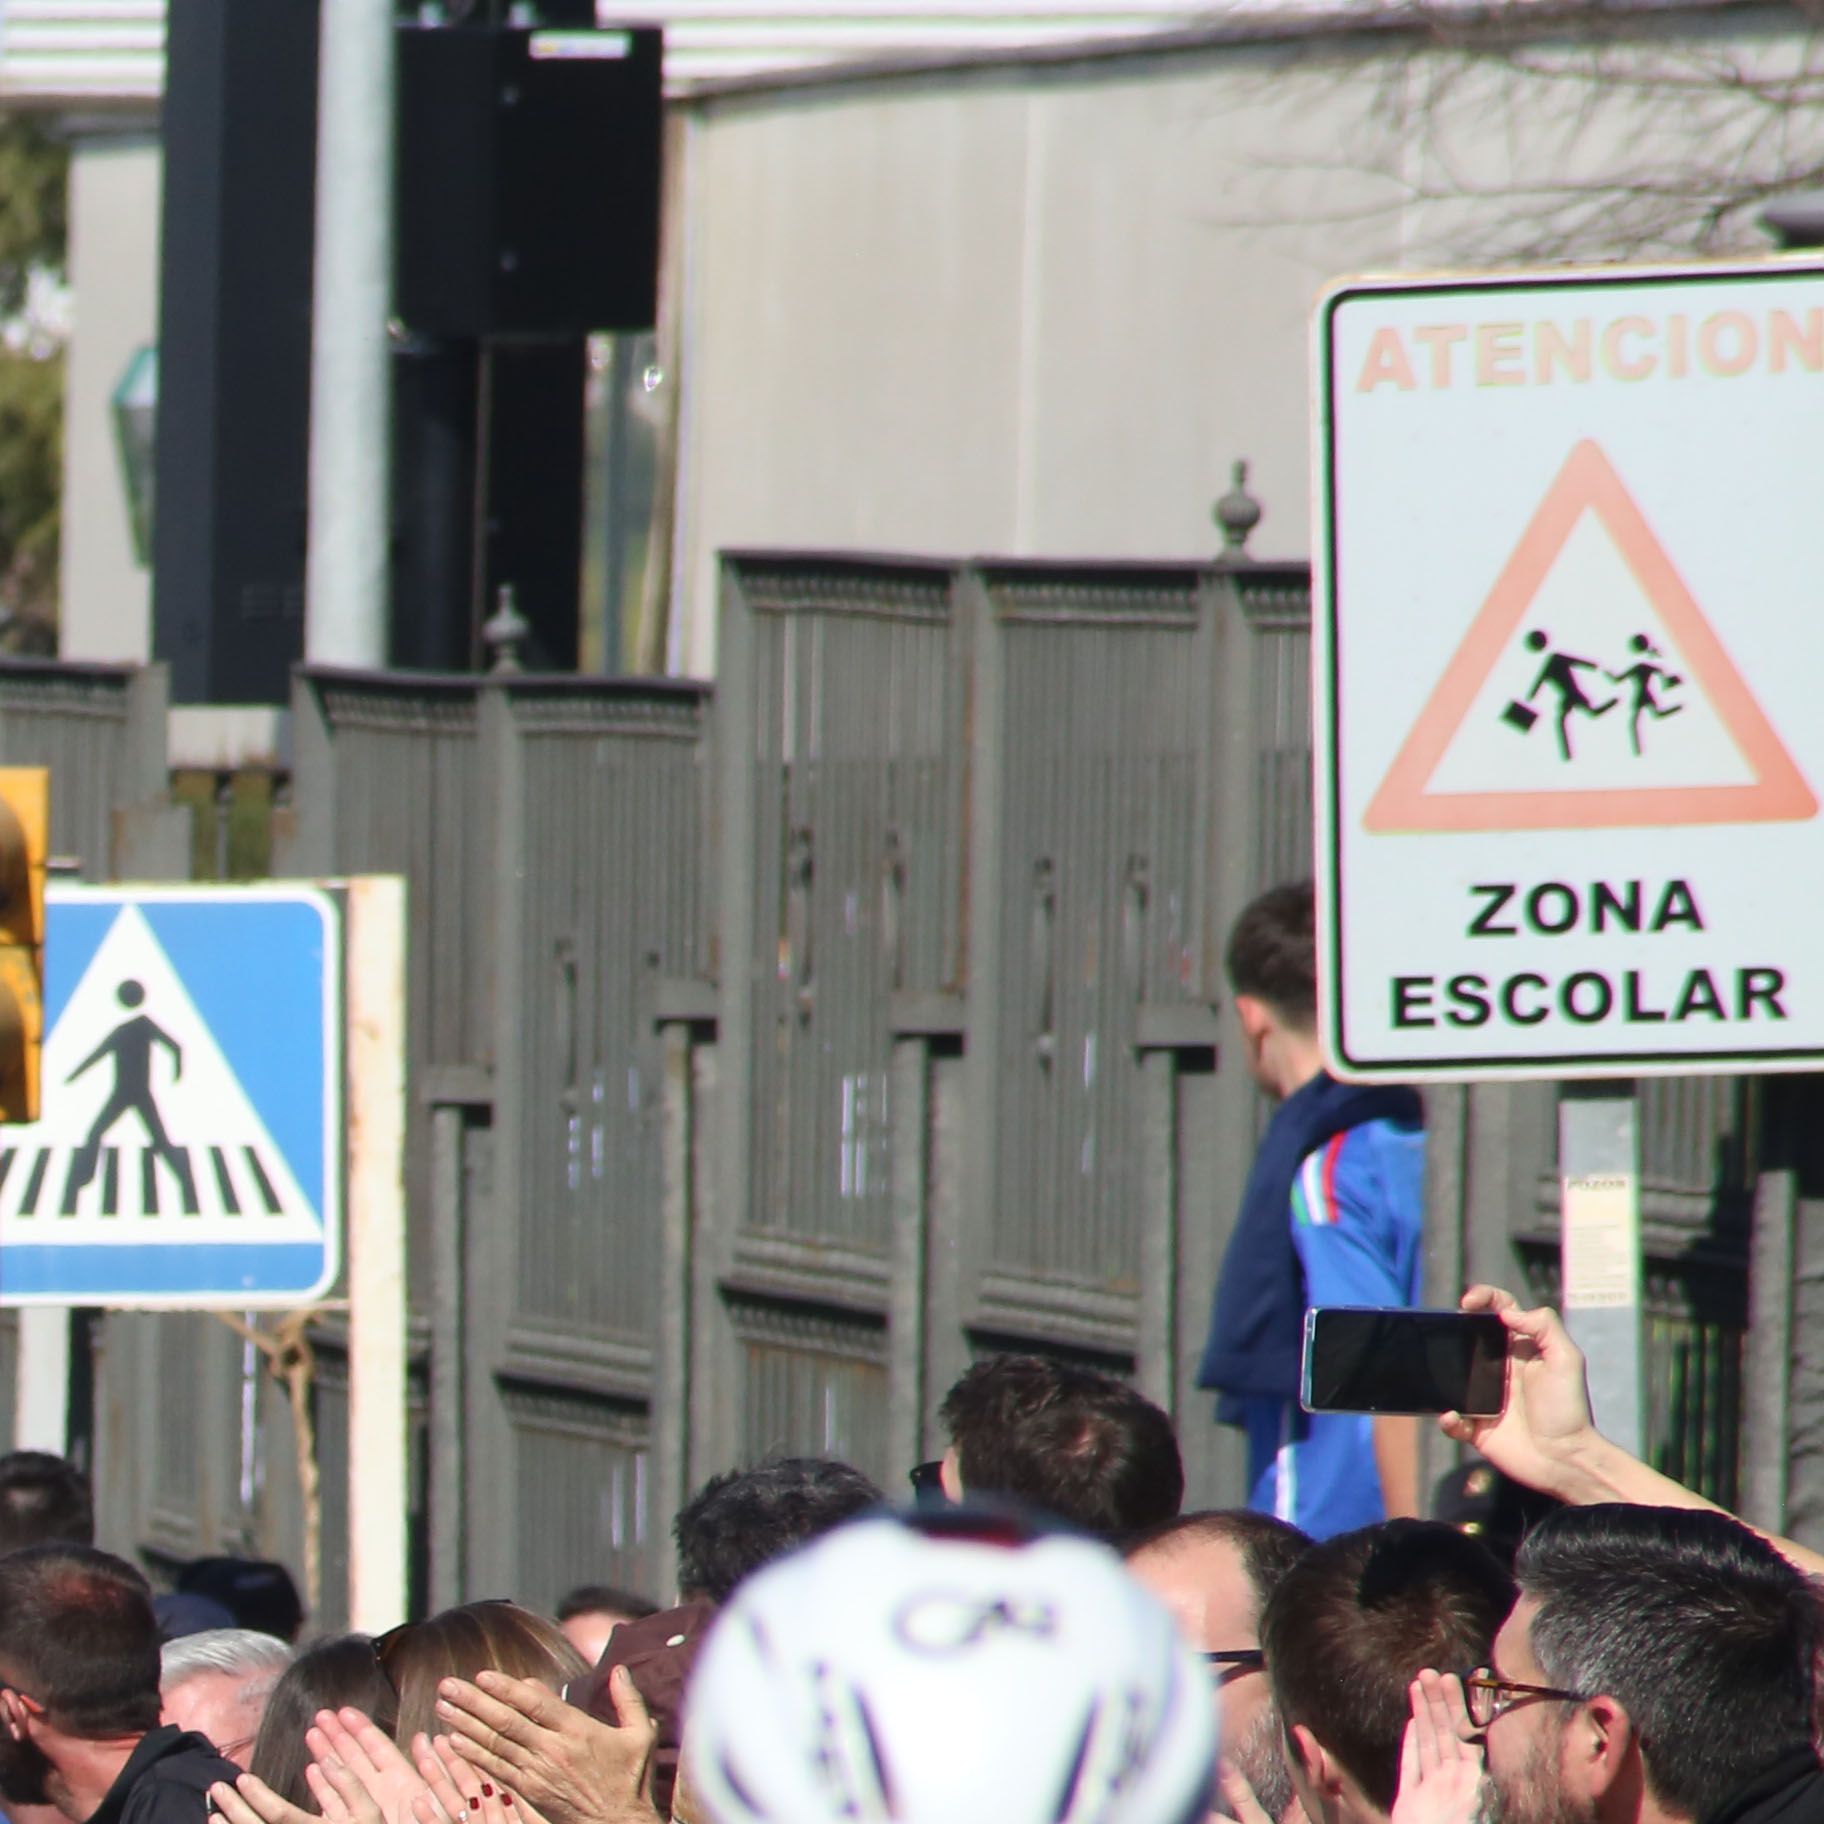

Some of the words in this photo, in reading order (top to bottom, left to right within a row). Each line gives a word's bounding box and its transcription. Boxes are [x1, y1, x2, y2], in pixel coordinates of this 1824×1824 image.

[1355, 307, 1824, 393] ATENCION
[1465, 879, 1705, 940] ZONA
[1390, 966, 1789, 1031] ESCOLAR
